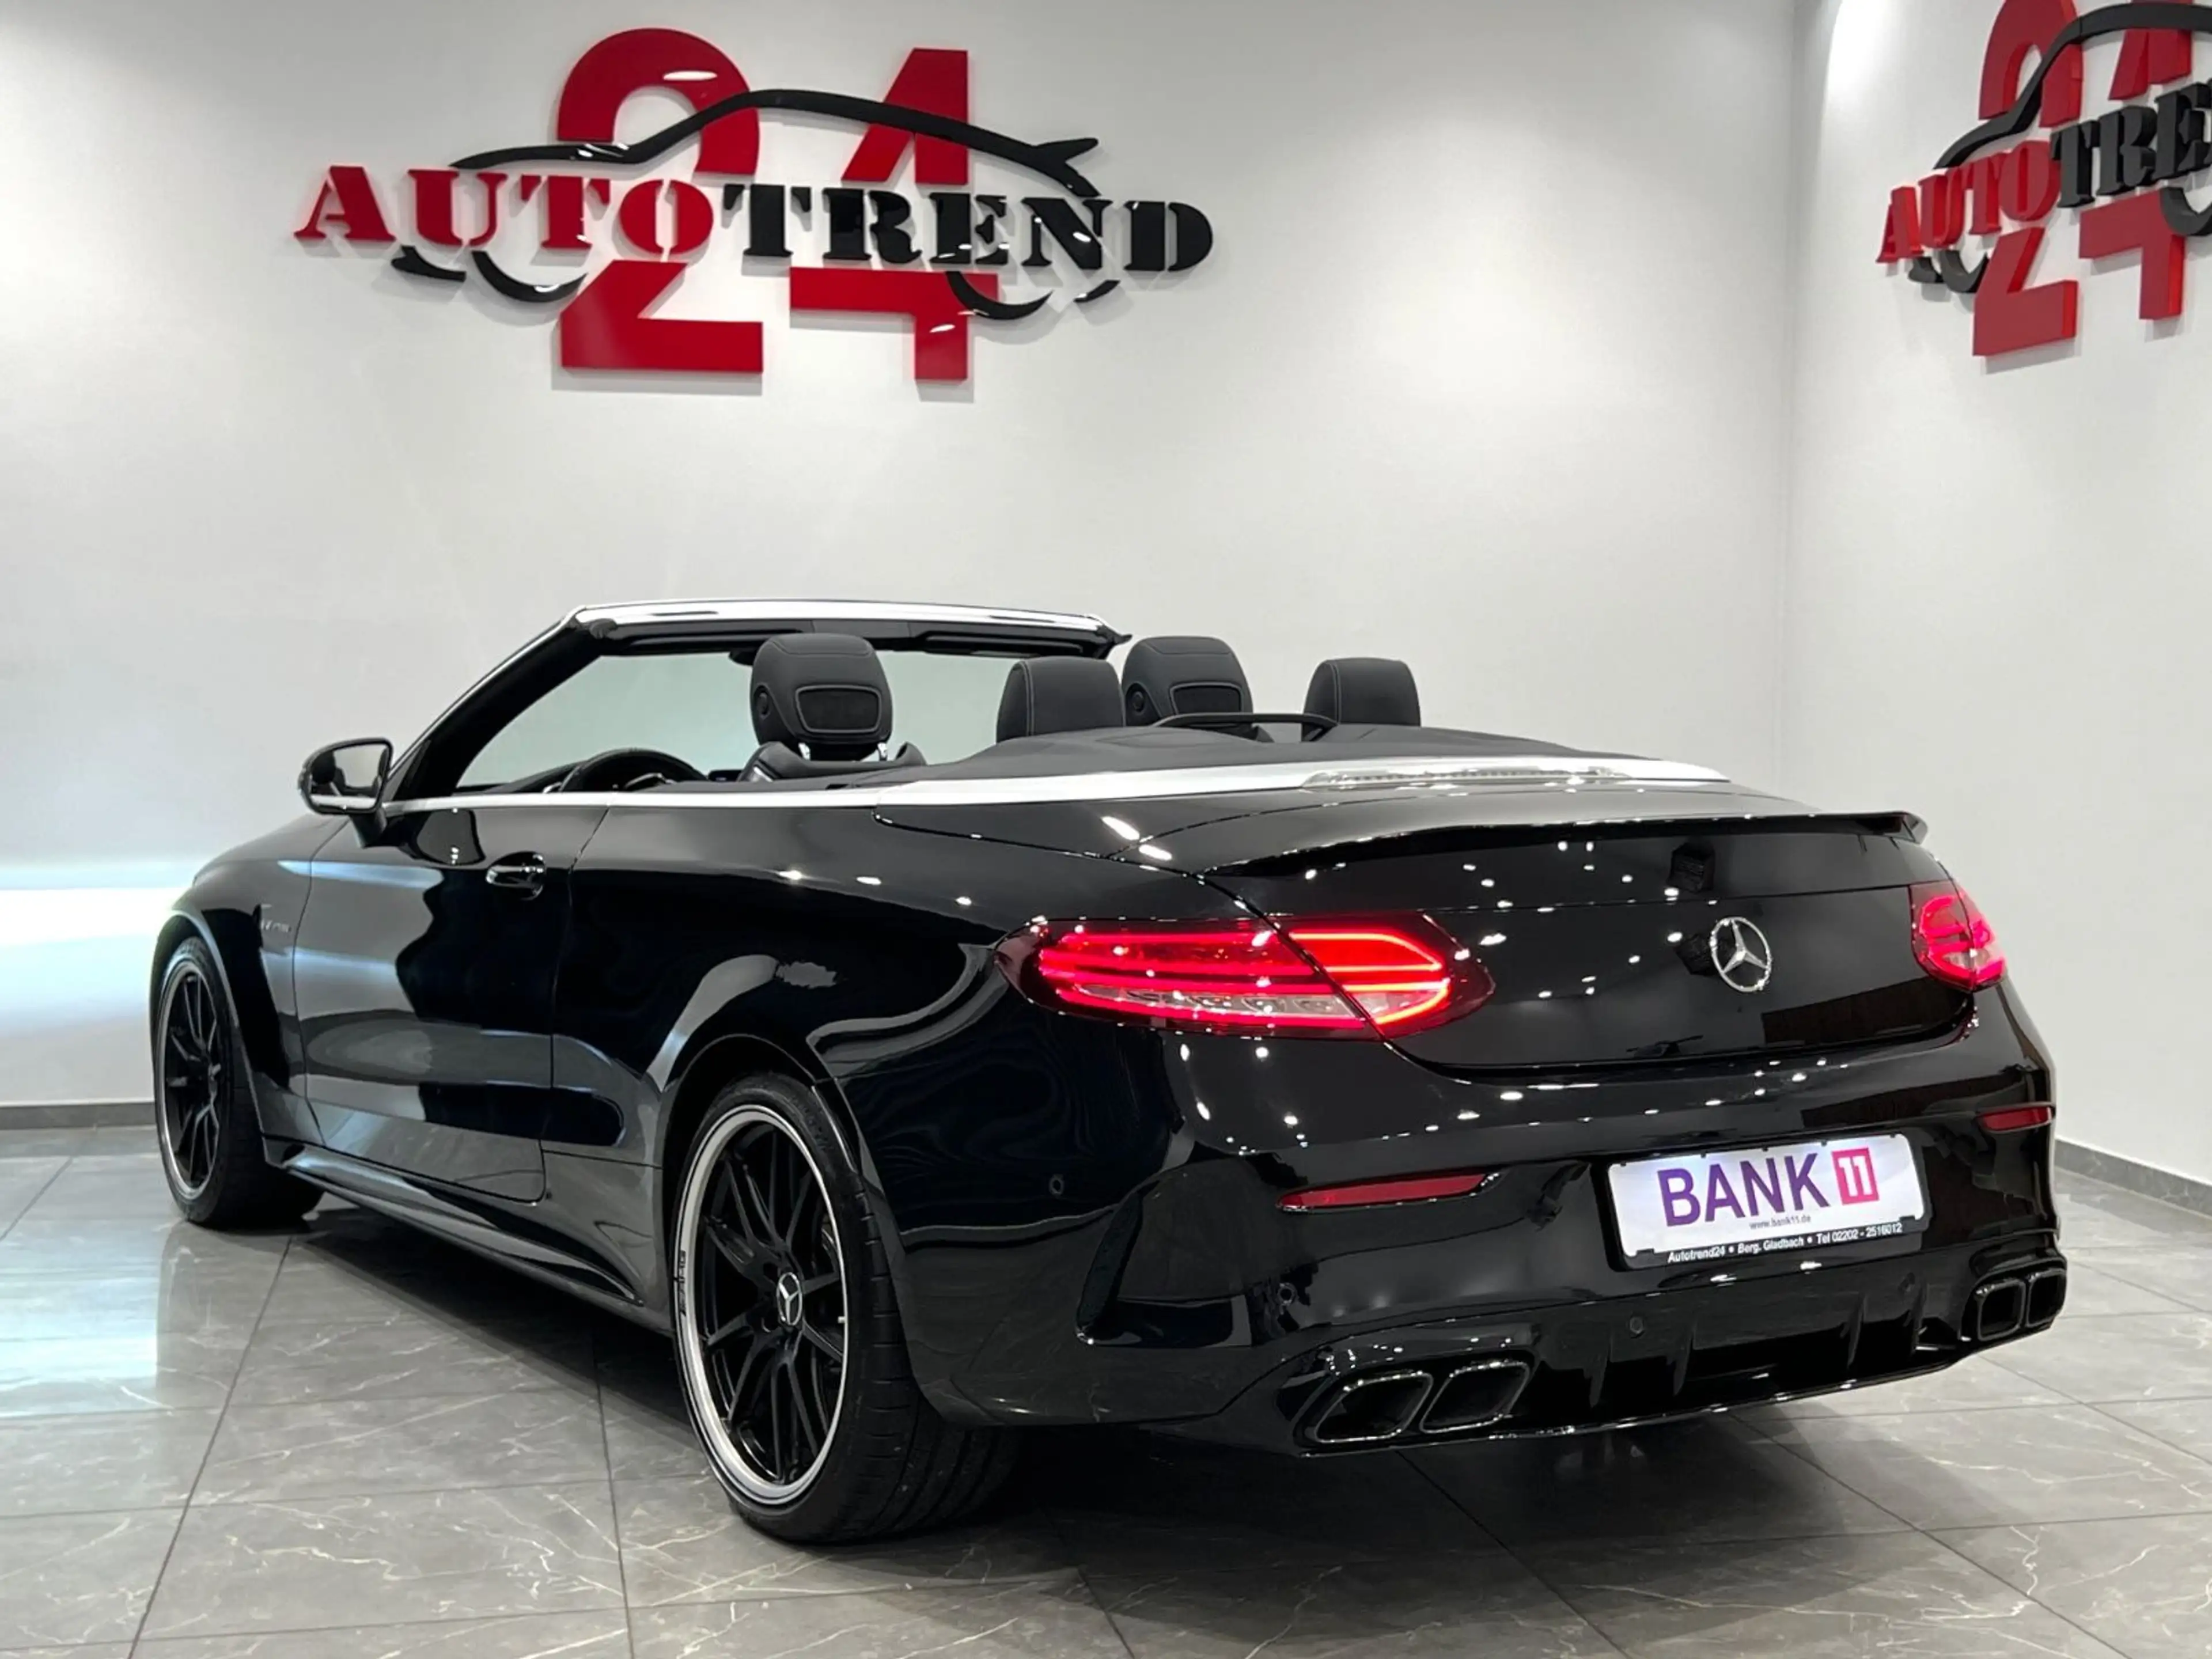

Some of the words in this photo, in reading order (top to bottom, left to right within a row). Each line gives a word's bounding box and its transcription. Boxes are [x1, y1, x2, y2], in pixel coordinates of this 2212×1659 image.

[293, 165, 1214, 273] AUTOTREND
[556, 28, 998, 381] 24
[1876, 78, 2212, 263] AUTOTRE
[1657, 1152, 1830, 1227] BANK
[1836, 1153, 1876, 1199] 11
[1667, 1245, 1726, 1264] Autotrend24
[1737, 1241, 1761, 1255] Berg.
[1763, 1236, 1804, 1251] Gladbach
[1816, 1232, 1830, 1245] Tel
[1832, 1229, 1858, 1243] 02202
